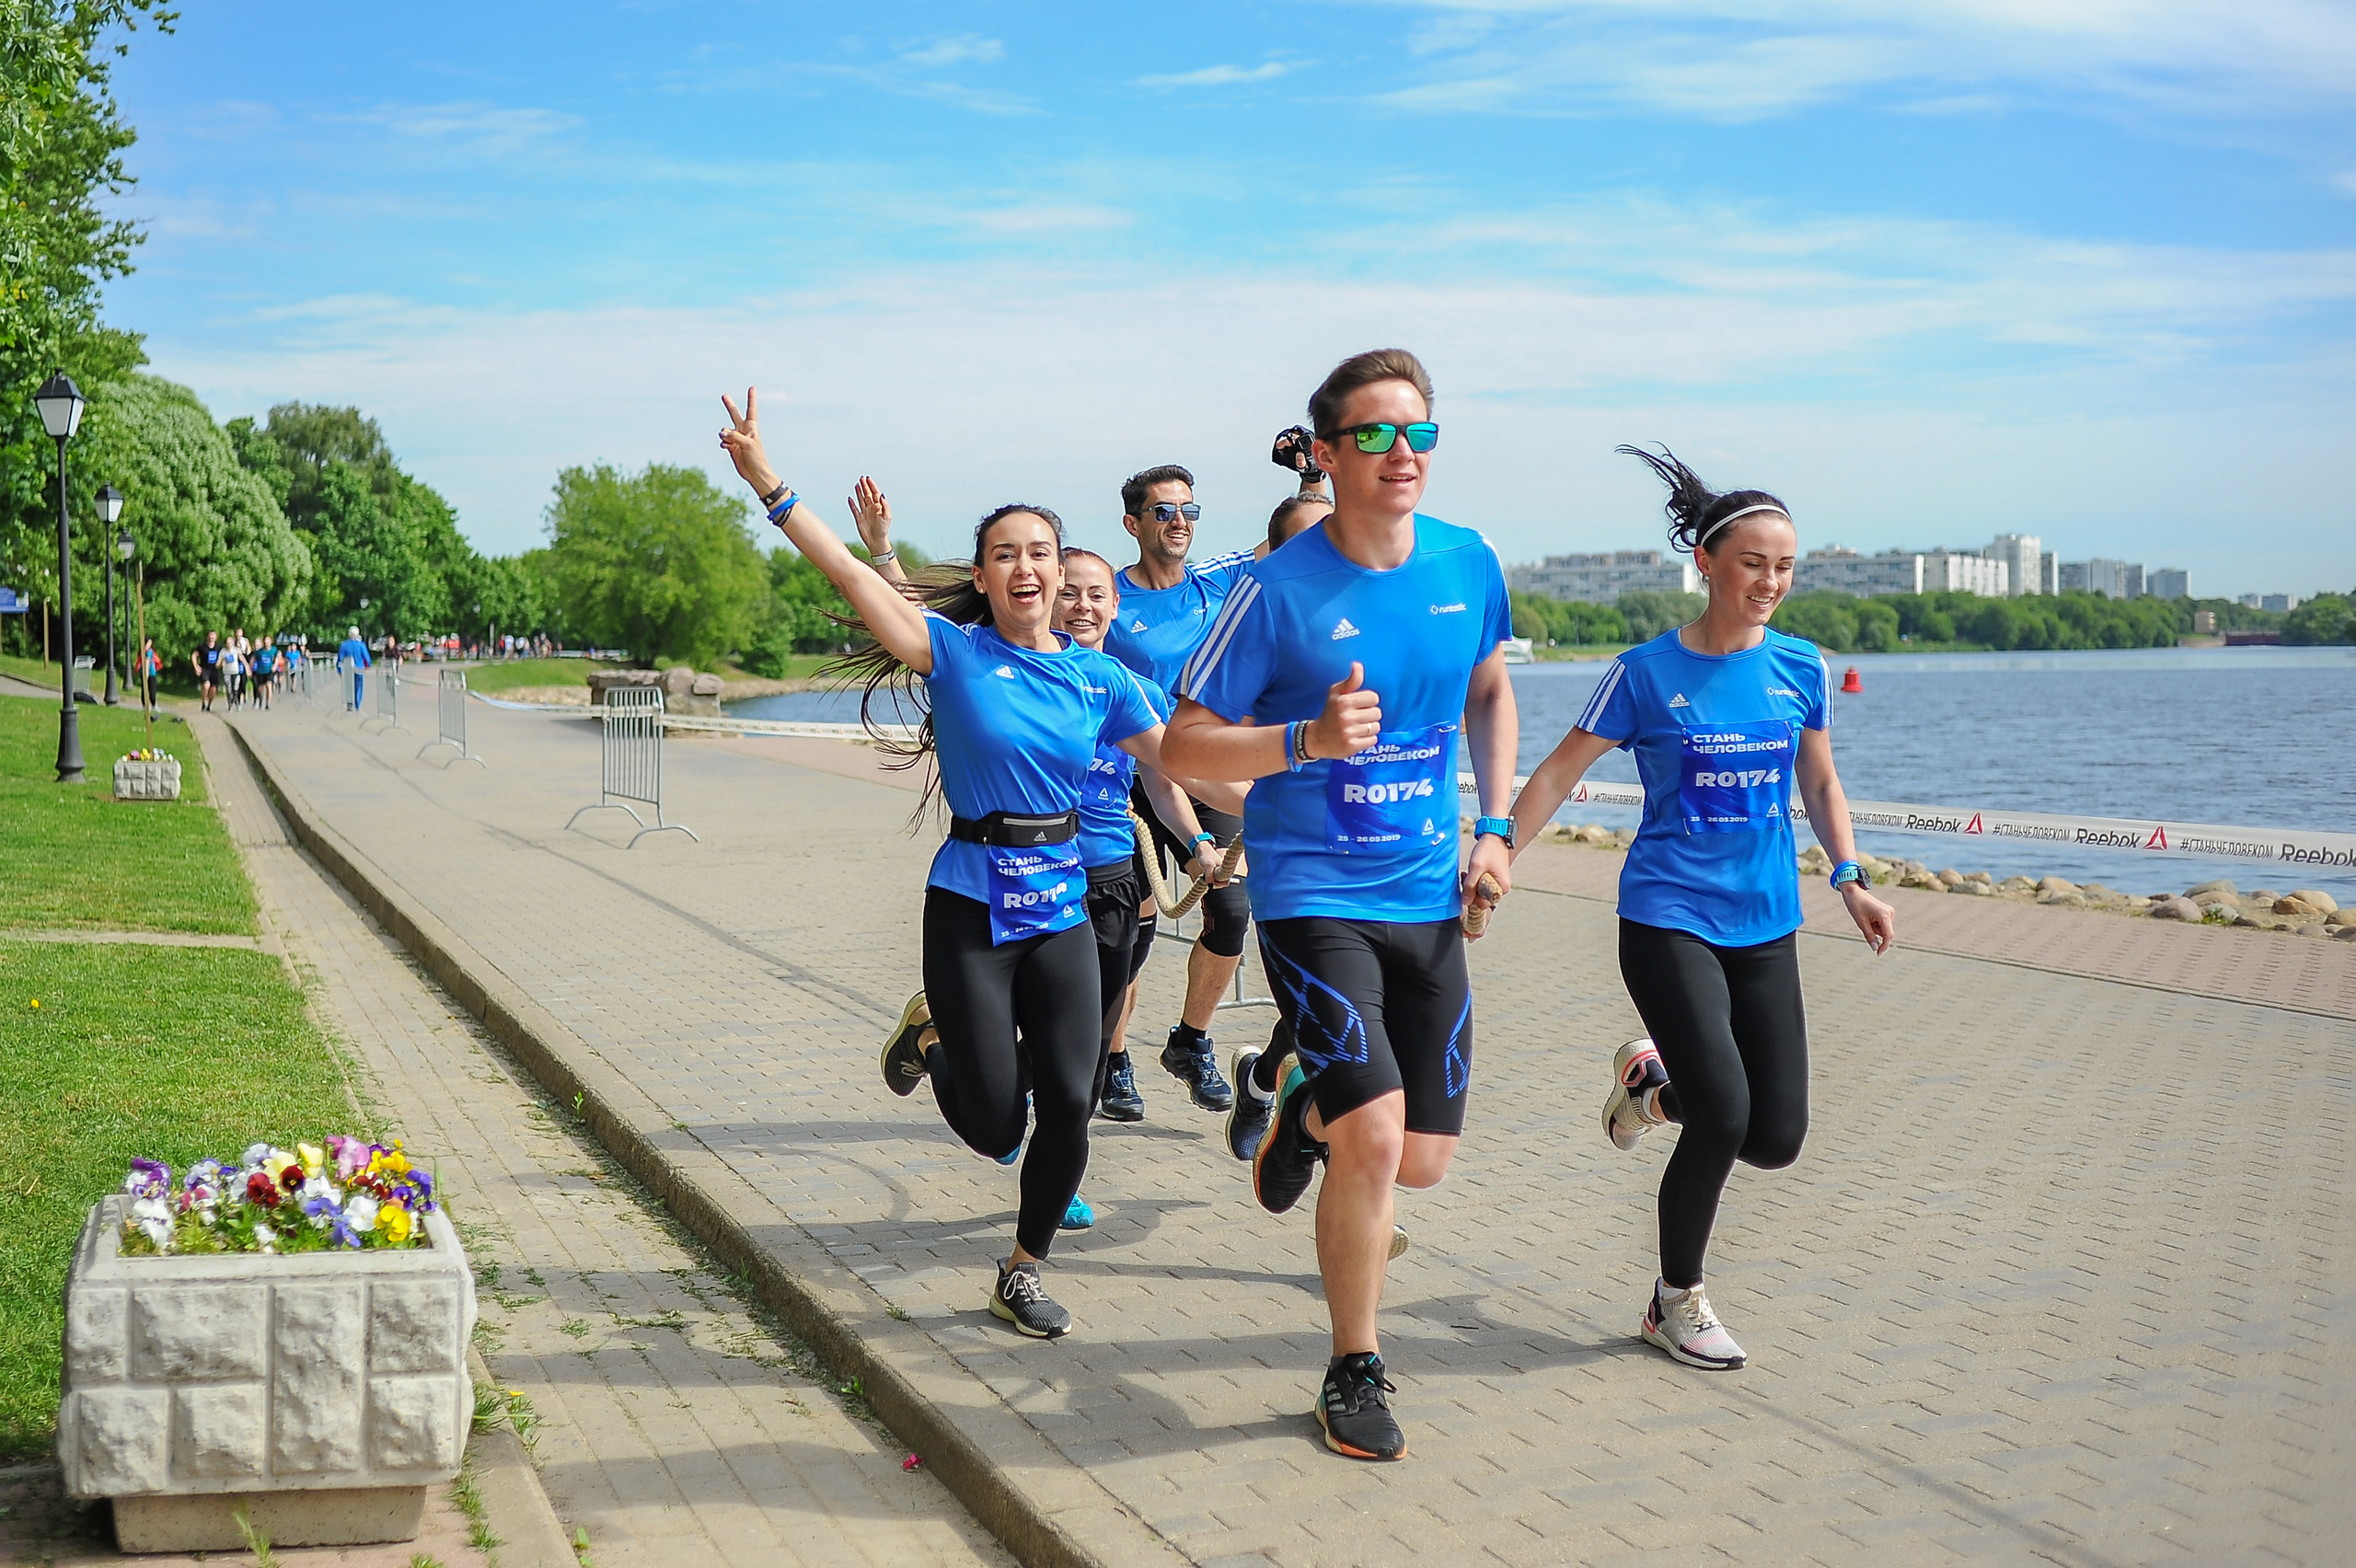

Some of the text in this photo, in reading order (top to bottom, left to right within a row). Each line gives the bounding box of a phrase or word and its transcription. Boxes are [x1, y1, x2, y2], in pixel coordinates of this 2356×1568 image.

[1332, 628, 1360, 640] adidas
[1692, 733, 1746, 743] СТАНЬ
[1359, 744, 1401, 755] АНЬ
[1692, 740, 1788, 754] ЧЕЛОВЕКОМ
[1344, 745, 1440, 766] ЧЕЛОВЕКОМ
[1695, 768, 1781, 788] R0174
[1344, 778, 1434, 803] R0174
[1848, 811, 1903, 827] ТАНЬЧЕЛОВЕКОМ
[1905, 813, 1961, 834] Reebok
[1992, 824, 2070, 841] #СТАНЬЧЕЛОВЕКОМ
[2073, 827, 2142, 848] Reebok
[2179, 838, 2274, 859] #СТАНЬЧЕЛОВЕКОМ
[998, 856, 1043, 867] СТАНЬ
[998, 857, 1078, 876] ЧЕЛОВЕКОМ
